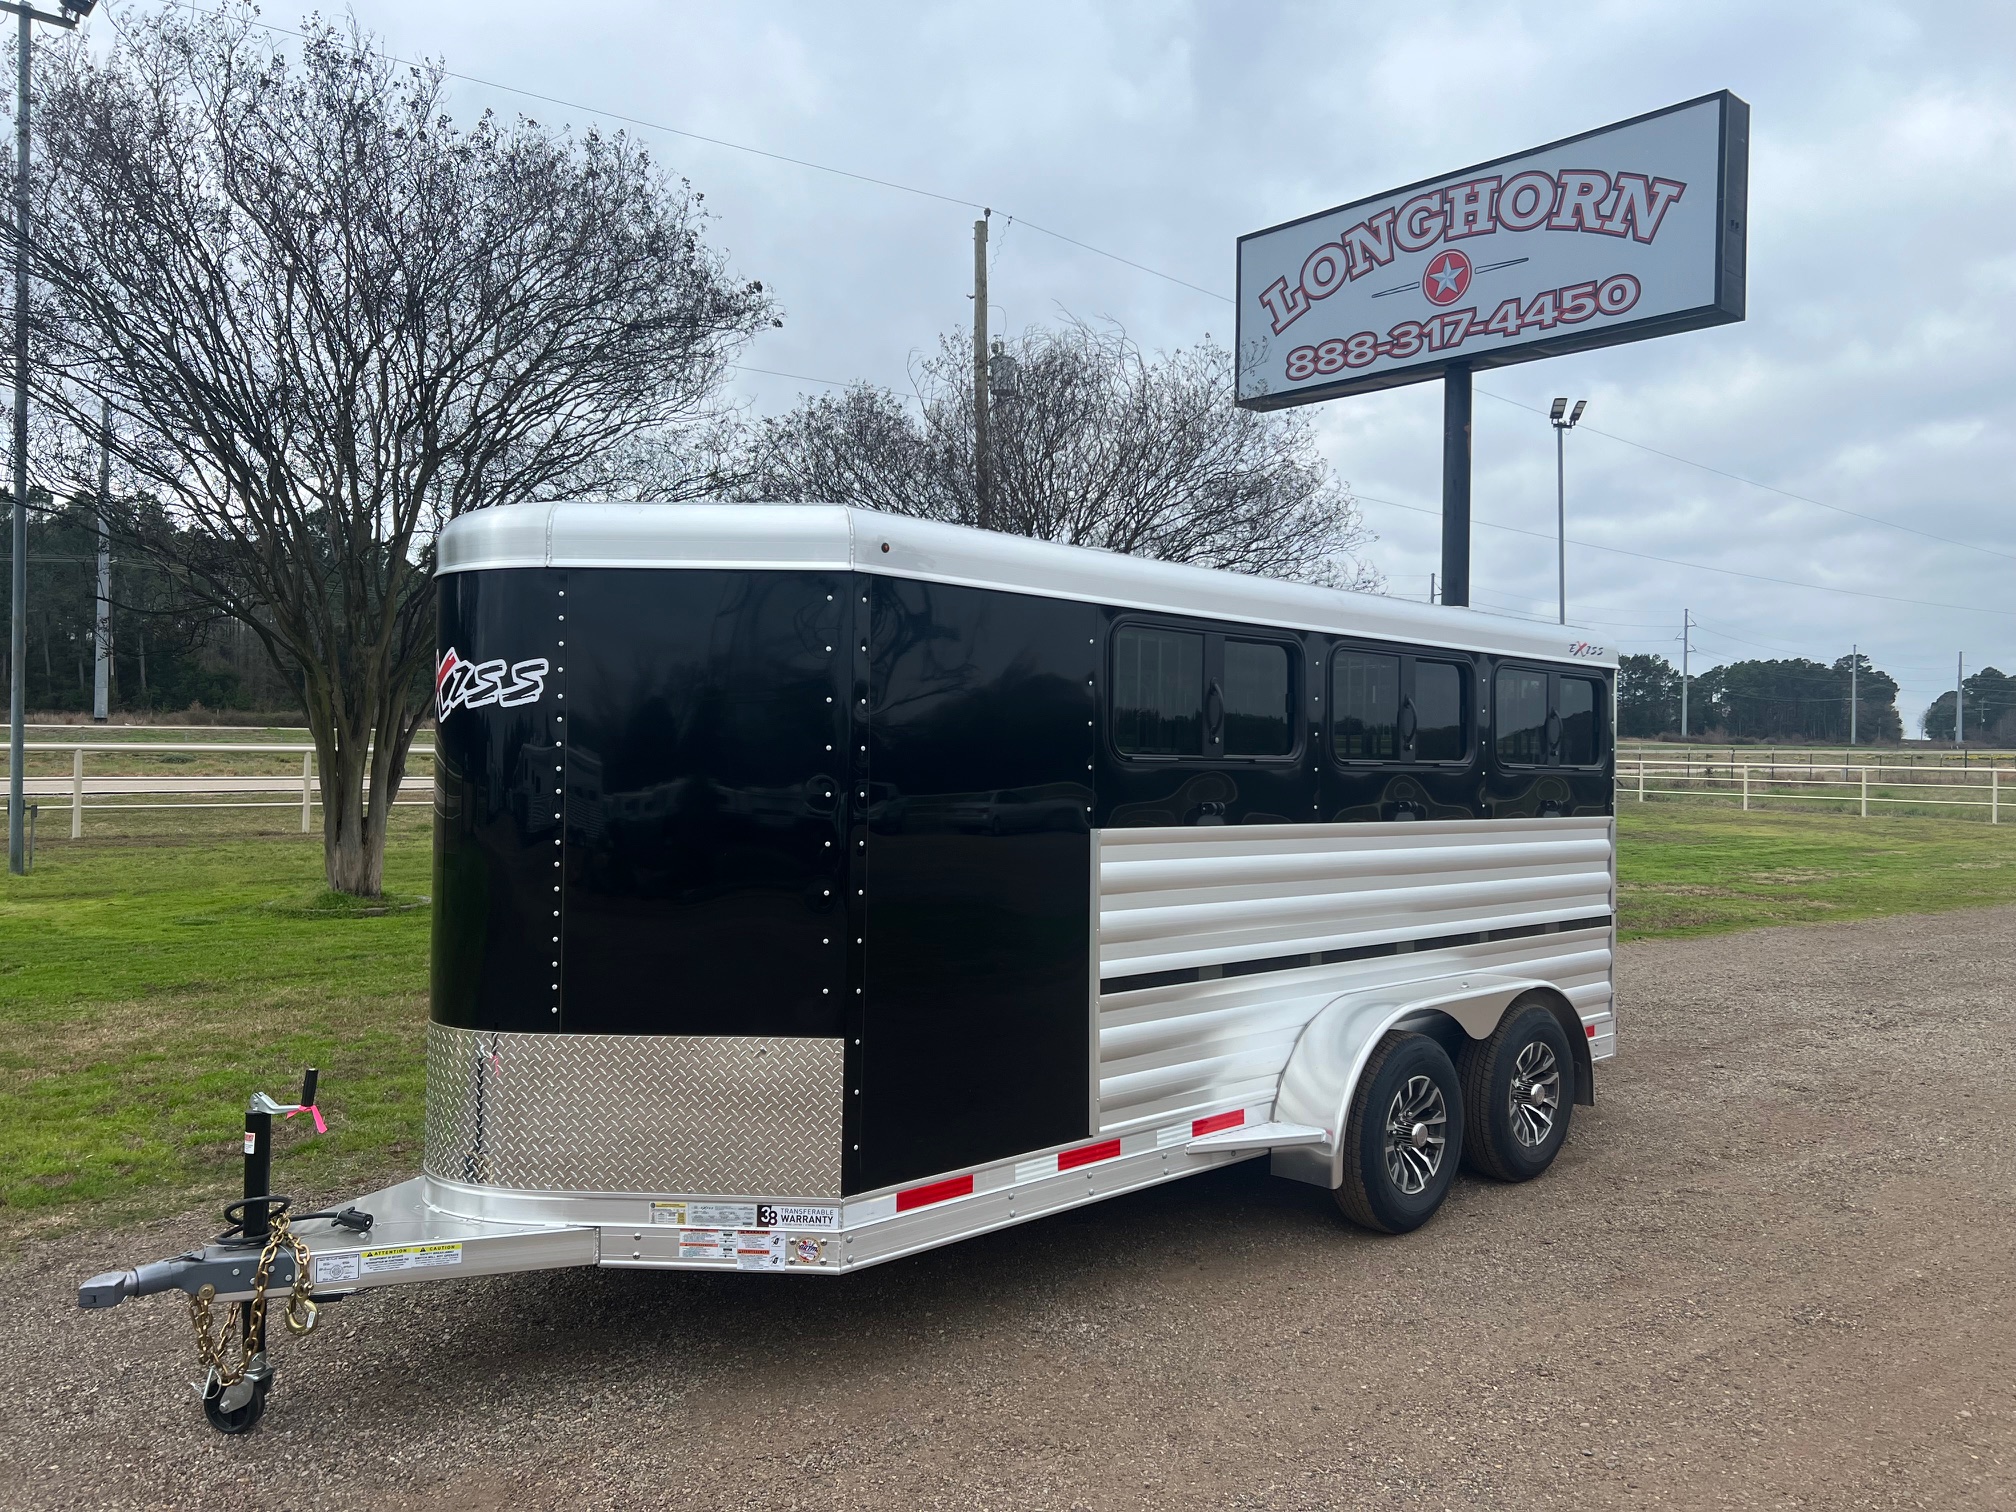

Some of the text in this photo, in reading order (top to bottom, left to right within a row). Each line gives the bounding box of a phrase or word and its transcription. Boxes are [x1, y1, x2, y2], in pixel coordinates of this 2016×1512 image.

[1259, 169, 1687, 336] LONGHORN
[1286, 273, 1642, 381] 888-317-4450
[781, 1215, 834, 1224] WARRANTY
